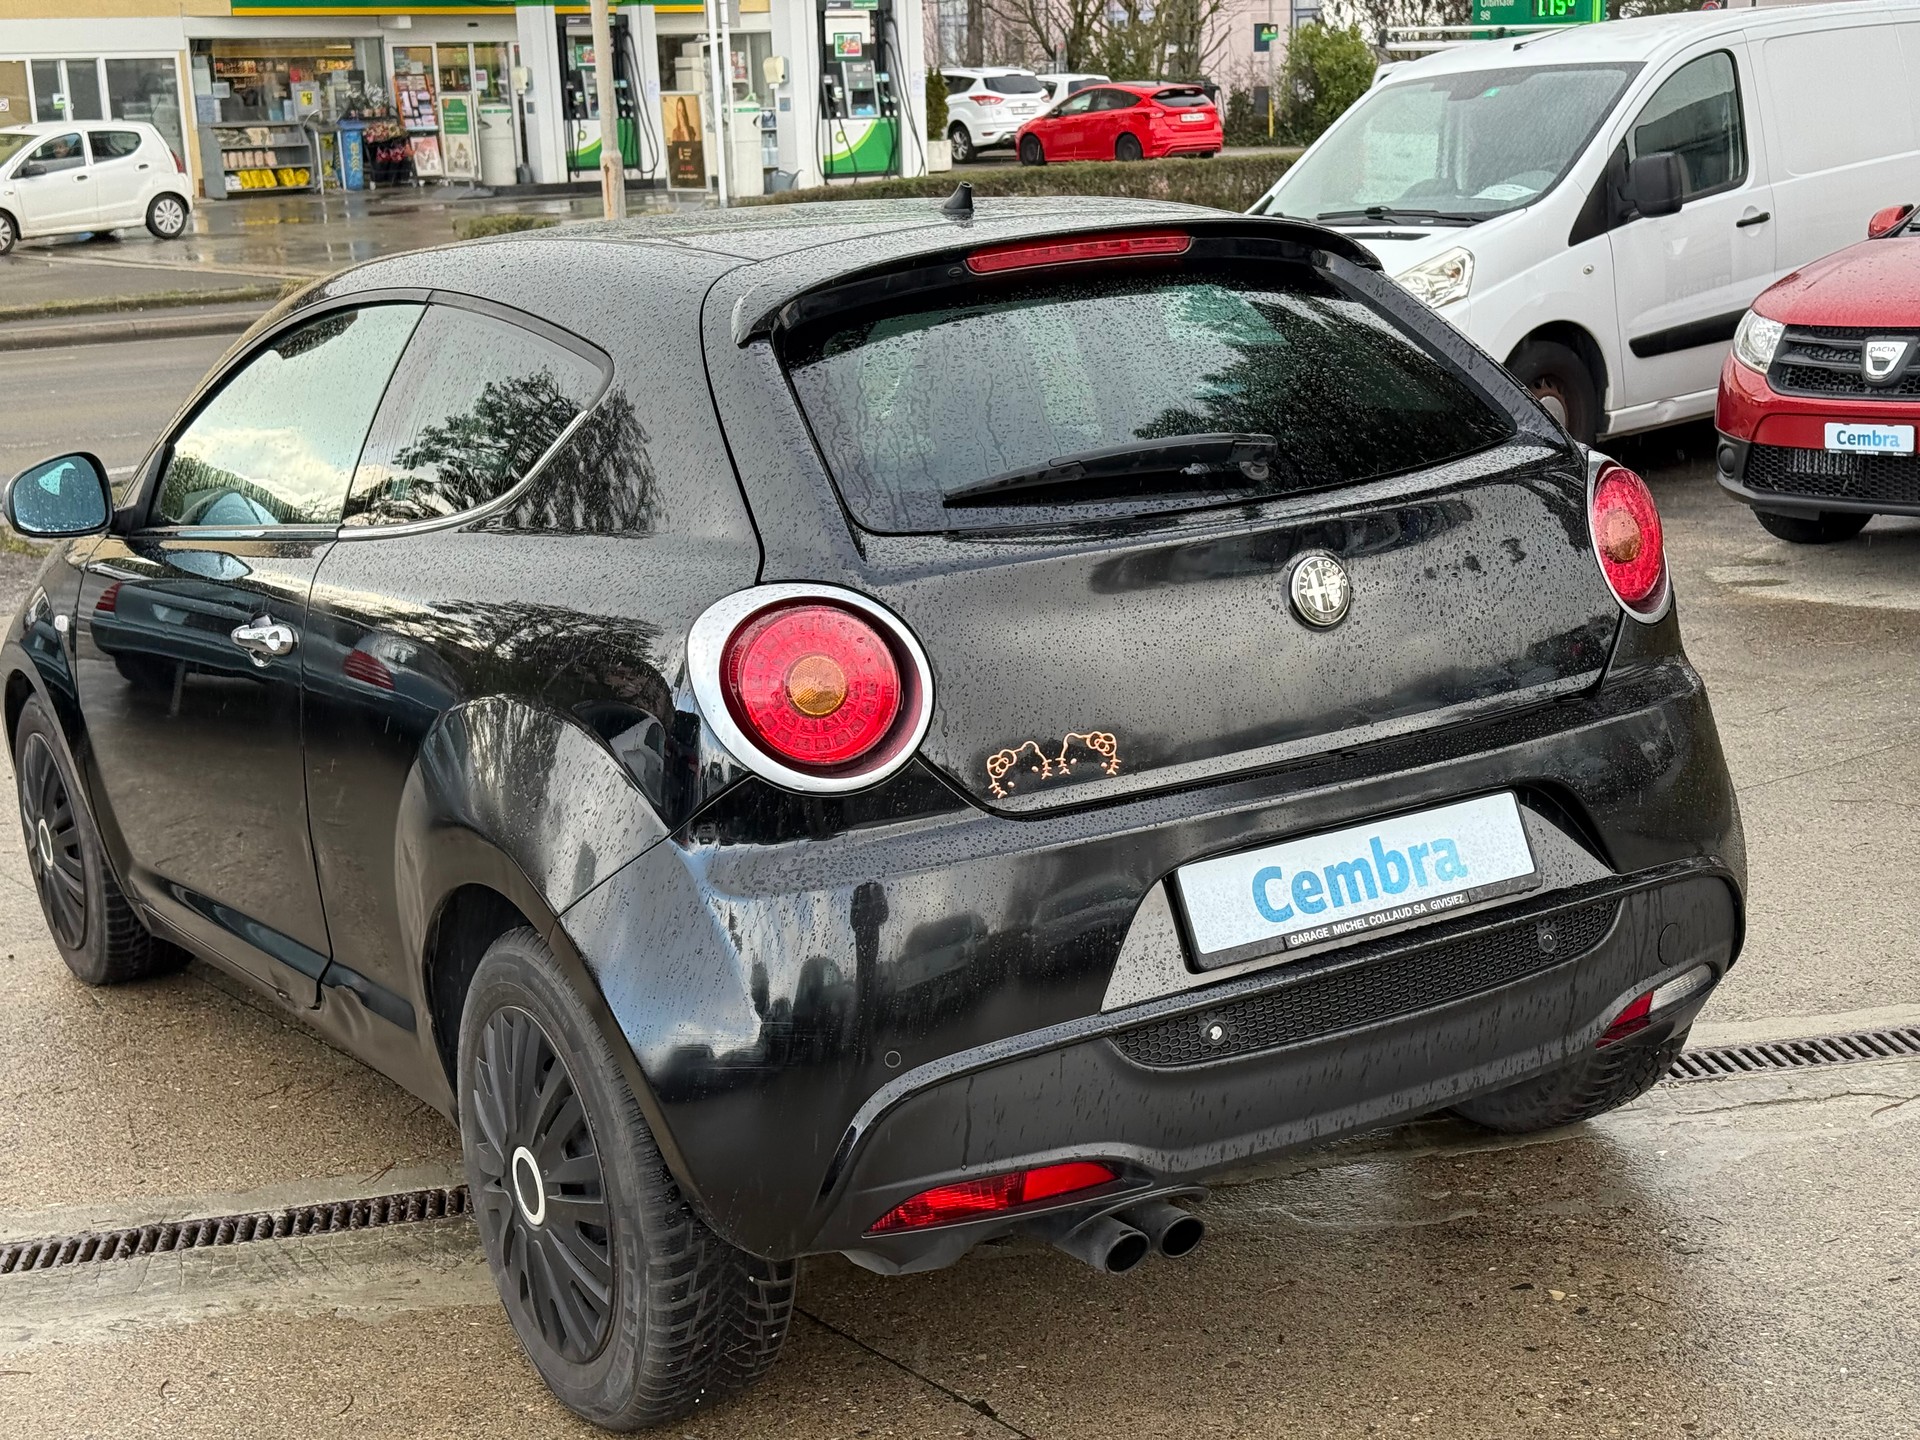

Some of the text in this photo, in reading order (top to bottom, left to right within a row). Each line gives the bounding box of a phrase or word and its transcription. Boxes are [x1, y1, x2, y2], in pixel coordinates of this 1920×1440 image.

[1836, 429, 1900, 448] Cembra
[1252, 836, 1468, 923] Cembra
[1290, 894, 1465, 945] GARAGE MICHEL COLLAUD SA GIVISIEZ
